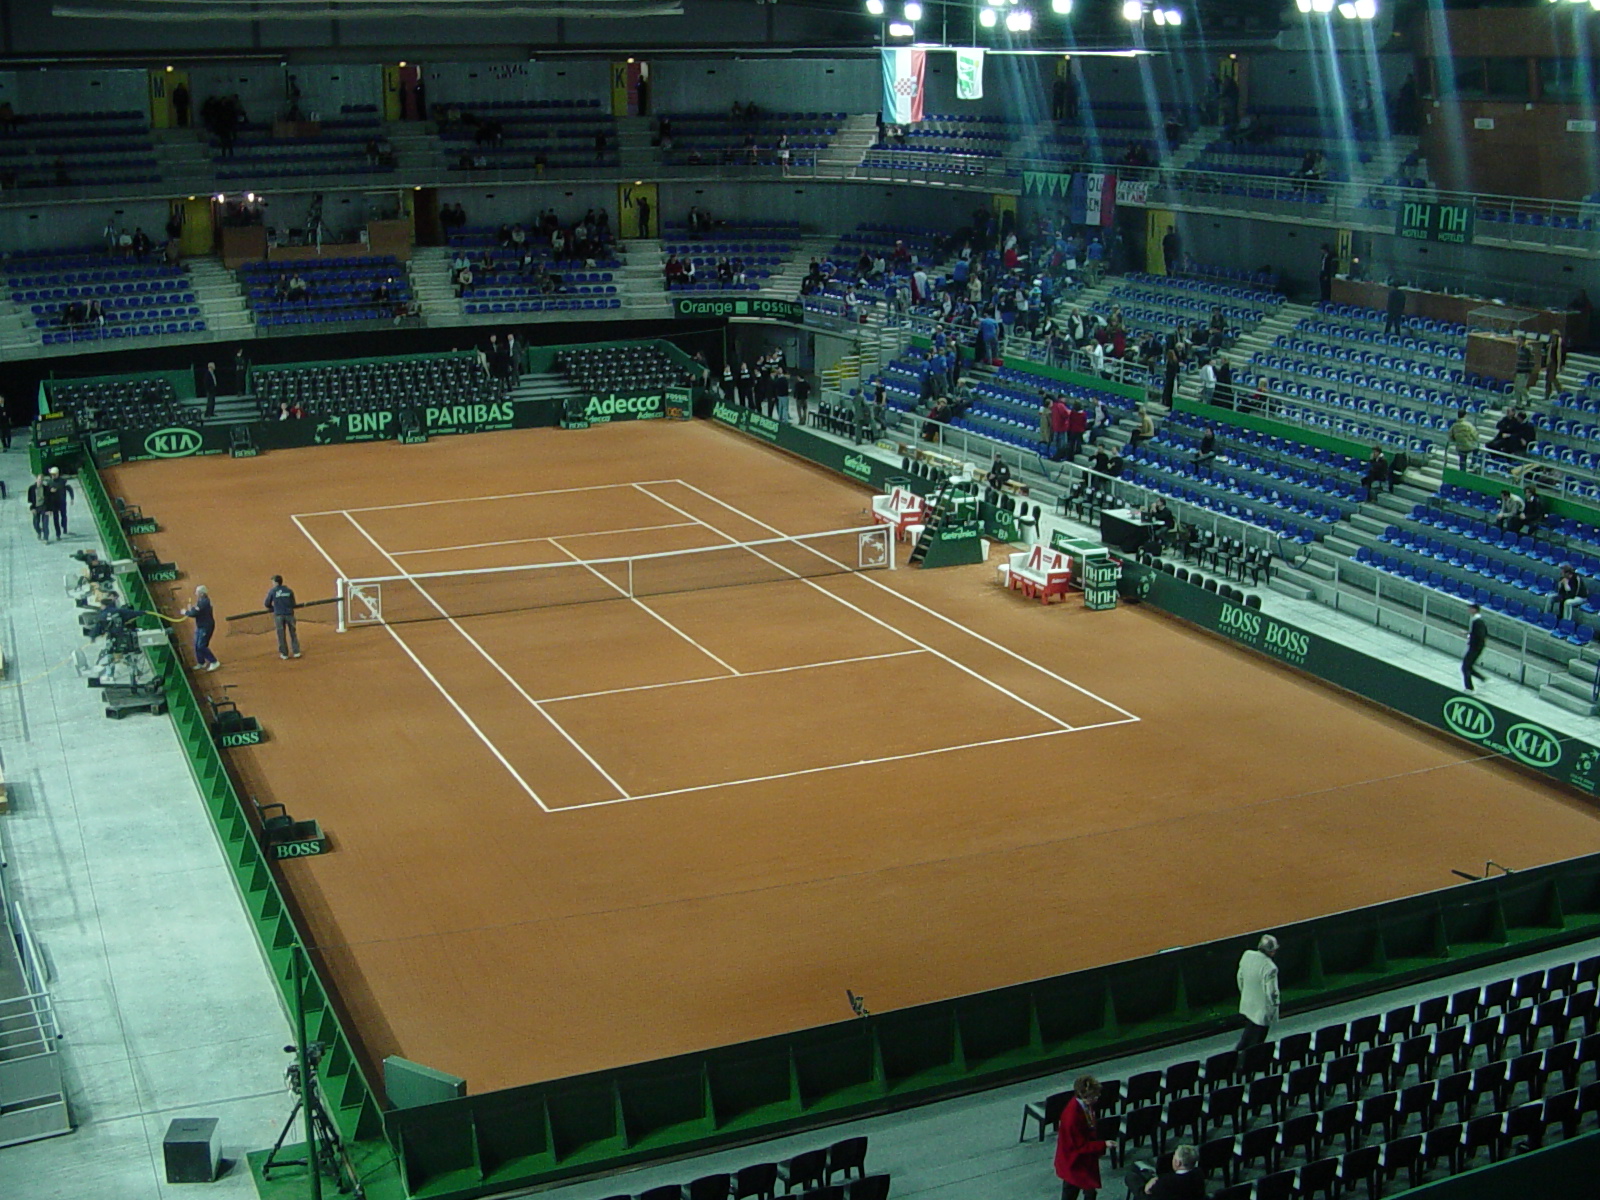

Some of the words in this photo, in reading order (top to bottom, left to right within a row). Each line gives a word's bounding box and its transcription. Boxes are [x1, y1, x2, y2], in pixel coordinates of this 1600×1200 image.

[153, 76, 165, 98] M
[388, 71, 396, 92] L
[615, 67, 625, 88] K
[623, 188, 633, 208] K
[680, 300, 733, 316] Orange
[753, 300, 792, 314] FOSSIL
[585, 394, 661, 415] Adecco
[348, 411, 393, 433] BNP
[426, 402, 514, 427] PARIBAS
[155, 434, 194, 451] KIA
[1220, 603, 1262, 636] BOSS
[1265, 621, 1310, 656] BOSS
[222, 731, 260, 747] BOSS
[1451, 703, 1485, 733] KIA
[1515, 729, 1551, 762] KIA
[277, 841, 321, 858] BOSS
